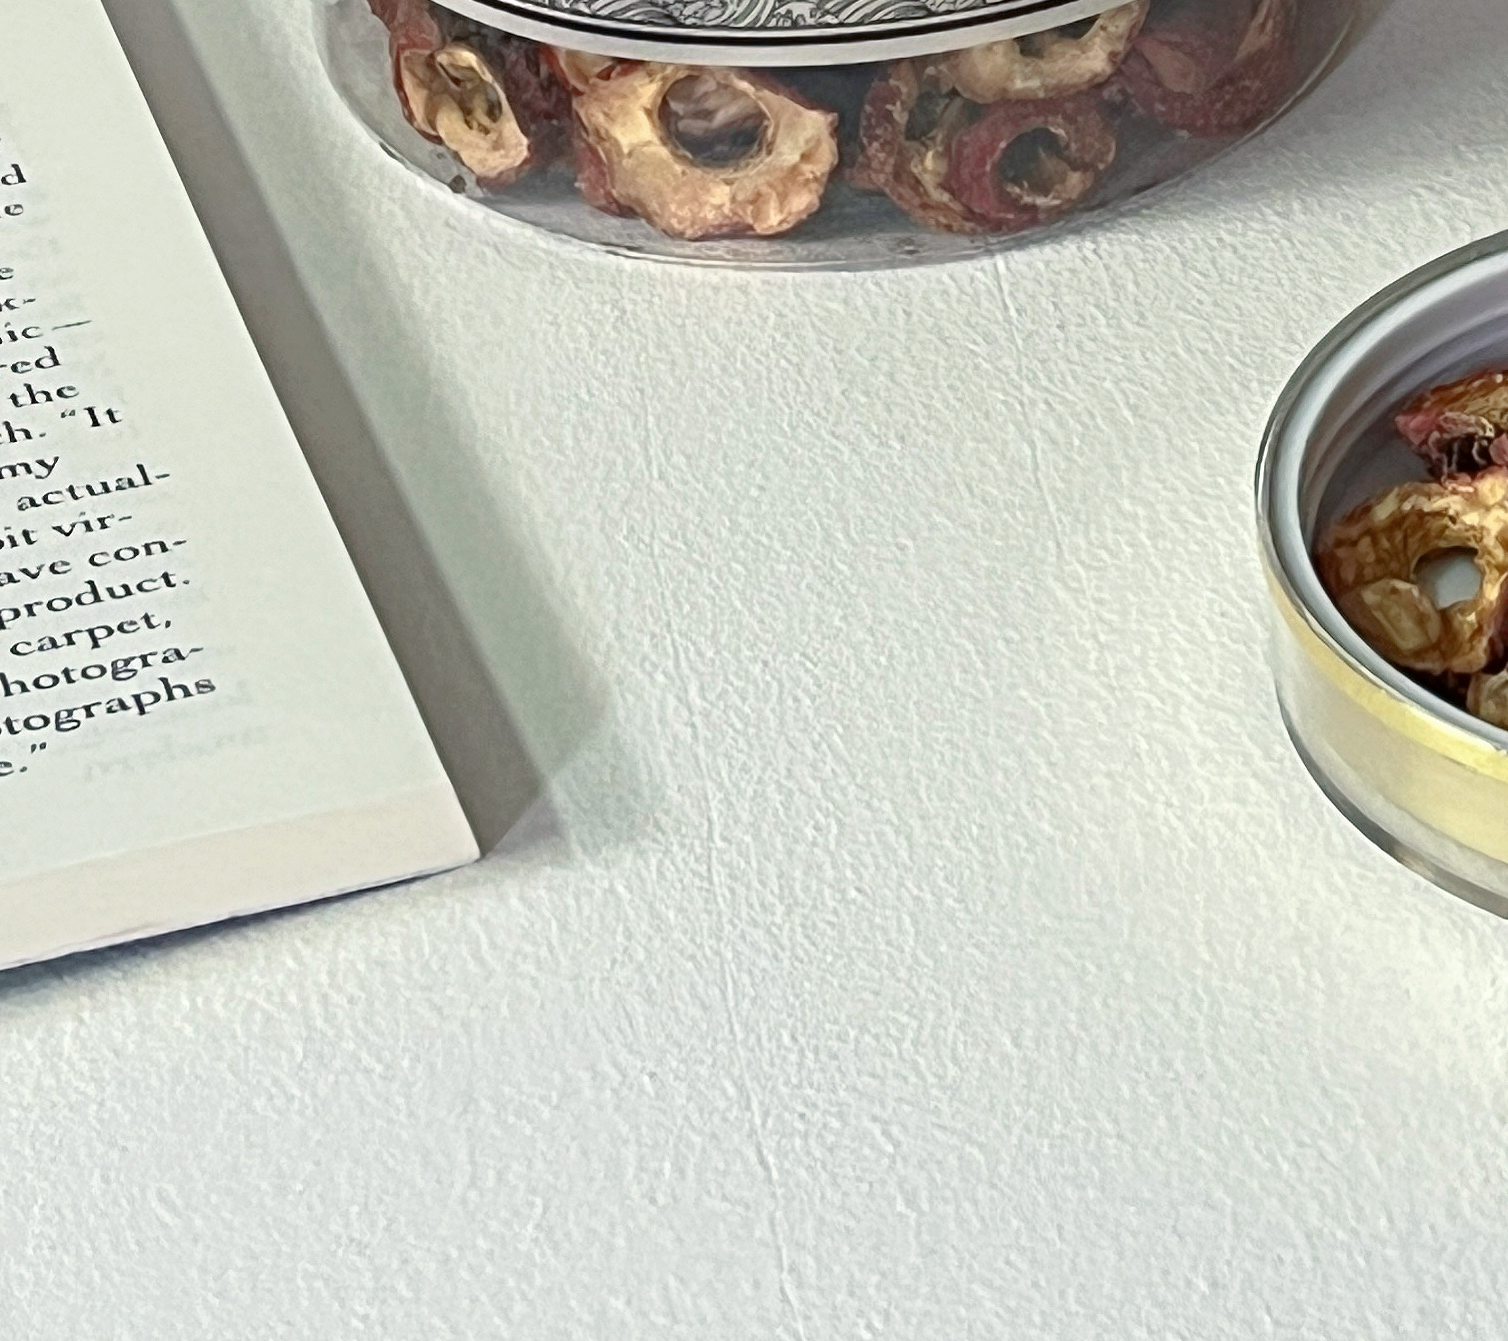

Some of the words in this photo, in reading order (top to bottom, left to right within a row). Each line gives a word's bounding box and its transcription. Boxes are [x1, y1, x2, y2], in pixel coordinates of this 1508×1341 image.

[8, 383, 80, 408] the
[17, 463, 171, 512] actual-
[52, 511, 133, 537] vir-
[88, 540, 188, 567] con-
[0, 571, 190, 630] product.
[10, 612, 172, 657] carpet,
[0, 677, 216, 736] tographs
